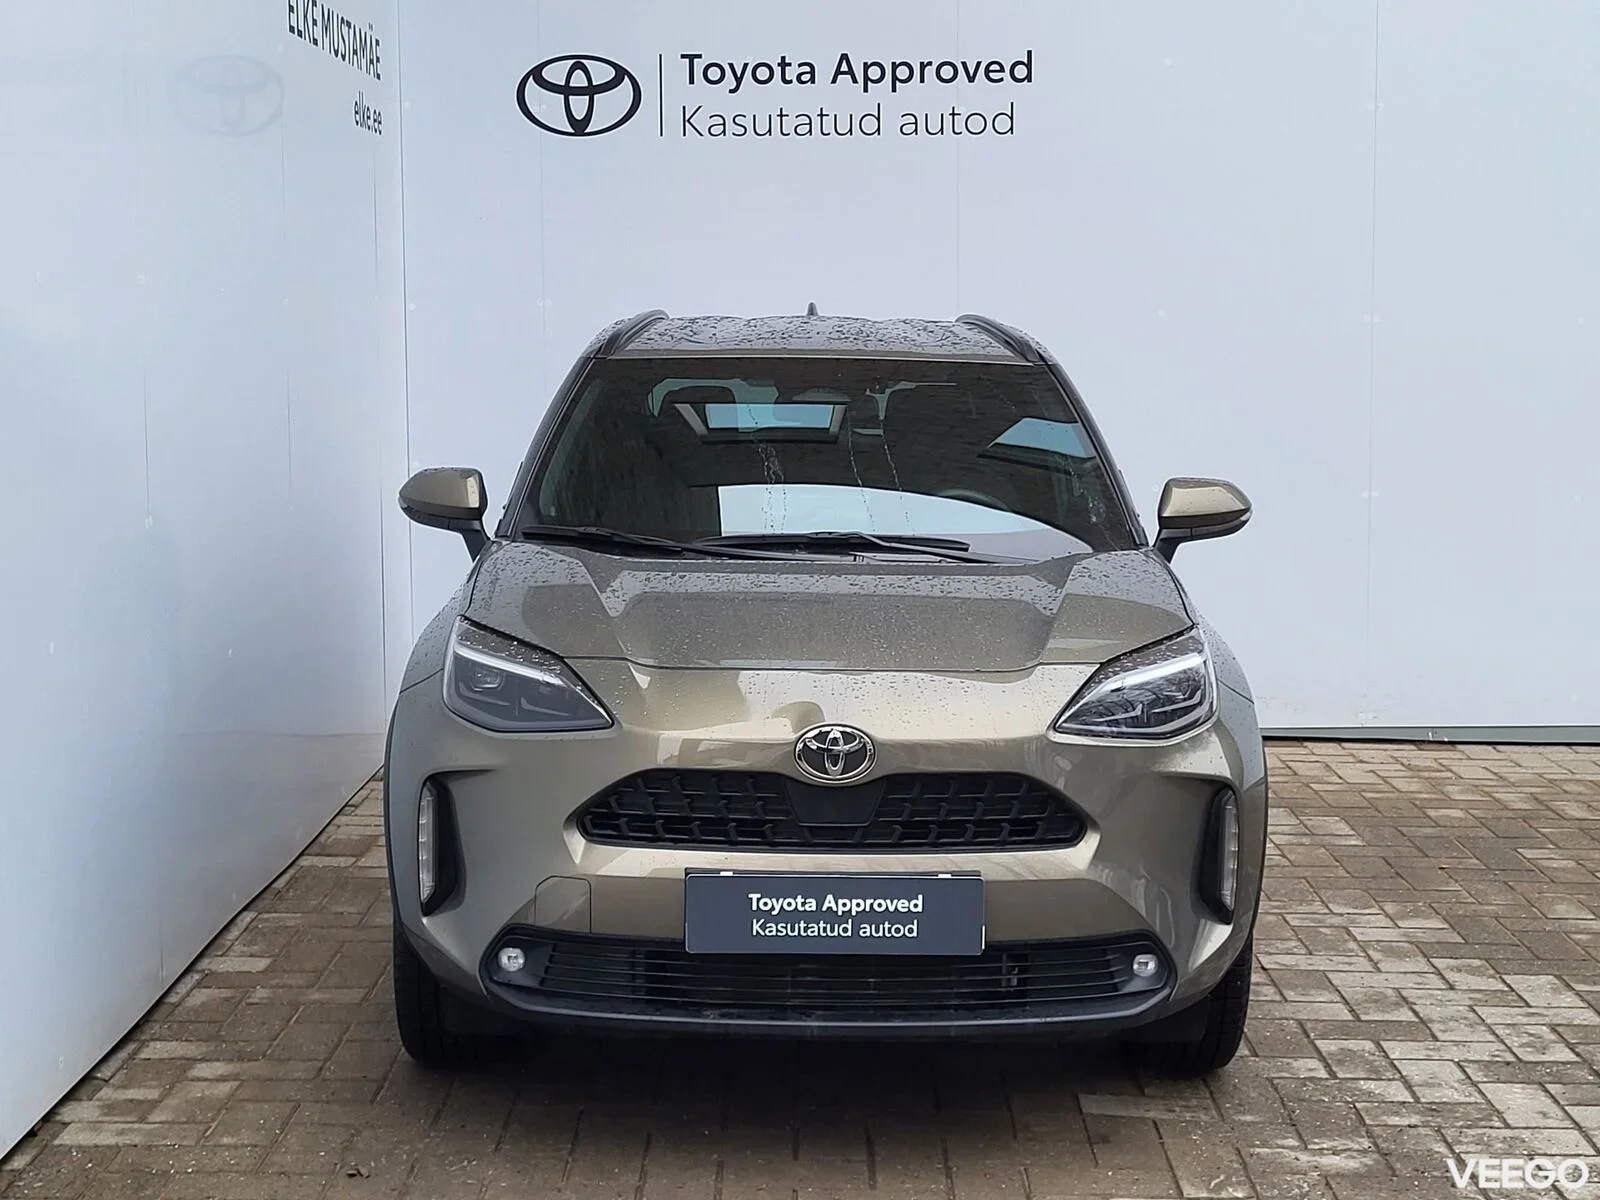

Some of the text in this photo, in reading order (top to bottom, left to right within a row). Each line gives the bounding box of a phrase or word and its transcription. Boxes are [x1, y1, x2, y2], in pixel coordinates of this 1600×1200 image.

[287, 0, 381, 81] ELKE MUSTAMÄE
[680, 50, 1034, 93] Toyota Approved
[353, 90, 383, 136] elke.ee
[681, 102, 1015, 137] Kasutatud autod
[748, 893, 924, 917] Toyota Approved
[752, 918, 919, 938] Kasutatud autod
